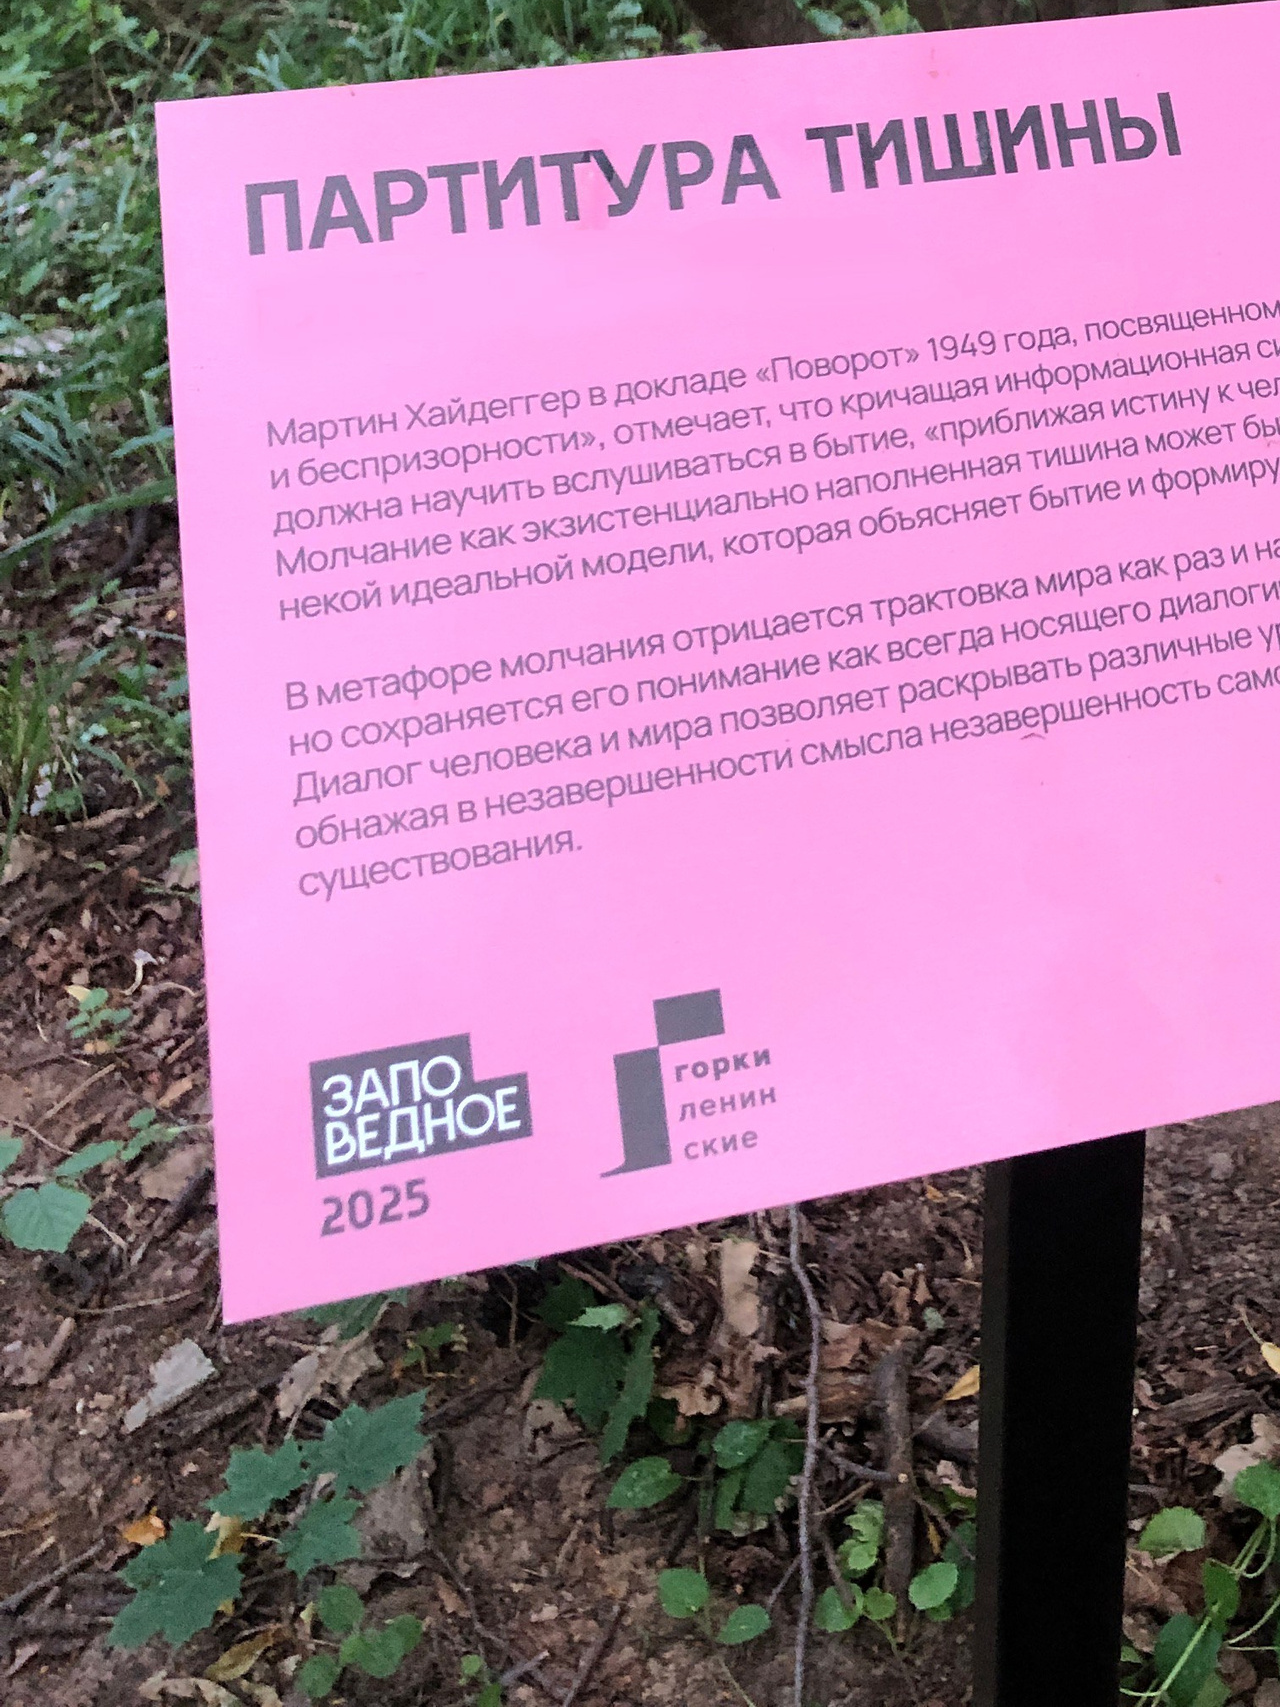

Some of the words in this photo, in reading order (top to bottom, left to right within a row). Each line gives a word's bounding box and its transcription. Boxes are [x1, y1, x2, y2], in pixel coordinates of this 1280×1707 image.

[246, 133, 781, 255] ПАРТИТУРА
[806, 92, 1183, 193] ТИШИНЫ
[266, 411, 399, 451] Мартин
[403, 388, 582, 431] Хайдеггер
[587, 385, 608, 408] в
[613, 367, 748, 409] докладе
[755, 346, 920, 384] «Поворот»
[926, 329, 998, 363] 1949
[1002, 325, 1079, 354] года,
[269, 467, 291, 491] и
[297, 430, 606, 488] беспризорности»,
[612, 404, 772, 446] отмечает,
[777, 396, 835, 422] что
[839, 375, 990, 421] кричащая
[994, 341, 1252, 396] информационная
[272, 495, 404, 539] должна
[410, 478, 546, 518] научить
[551, 444, 783, 497] вслушиваться
[788, 441, 808, 464] в
[811, 427, 916, 461] бытие,
[923, 400, 1106, 448] «приближая
[1109, 385, 1211, 419] истину
[1216, 383, 1236, 405] к
[275, 532, 453, 578] Молчание
[459, 523, 518, 552] как
[520, 482, 810, 544] экзистенциально
[814, 452, 1023, 502] наполненная
[1025, 435, 1140, 471] тишина
[1143, 421, 1238, 455] может
[278, 579, 383, 622] некой
[389, 552, 575, 607] идеальной
[580, 539, 715, 579] модели,
[721, 517, 853, 559] которая
[857, 492, 1023, 538] объясняет
[1027, 479, 1122, 513] бытие
[1126, 475, 1147, 499] и
[285, 680, 310, 712] В
[316, 659, 493, 707] метафоре
[499, 632, 666, 680] молчания
[671, 602, 865, 656] отрицается
[868, 576, 1030, 628] трактовка
[1033, 563, 1114, 599] мира
[1117, 554, 1170, 583] как
[1172, 546, 1227, 583] раз
[1229, 543, 1250, 566] и
[288, 728, 334, 757] но
[340, 693, 565, 749] сохраняется
[570, 683, 630, 713] его
[636, 652, 822, 704] понимание
[826, 642, 883, 673] как
[885, 624, 996, 663] всегда
[999, 600, 1153, 645] носящего
[292, 760, 422, 808] Диалог
[428, 734, 593, 780] человека
[599, 729, 621, 755] и
[626, 714, 714, 752] мира
[719, 685, 891, 735] позволяет
[896, 656, 1084, 714] раскрывать
[1086, 626, 1254, 683] различные
[294, 802, 450, 850] обнажая
[456, 799, 479, 824] в
[484, 746, 794, 820] незавершенности
[799, 725, 925, 767] смысла
[928, 678, 1212, 745] незавершенность
[298, 829, 583, 903] существования.
[322, 1054, 461, 1117] ЗАПО
[324, 1086, 521, 1166] ВЕДНОЕ
[674, 1048, 772, 1082] горки
[679, 1083, 778, 1123] ленин
[320, 1177, 431, 1237] 2025
[683, 1127, 760, 1161] ские
